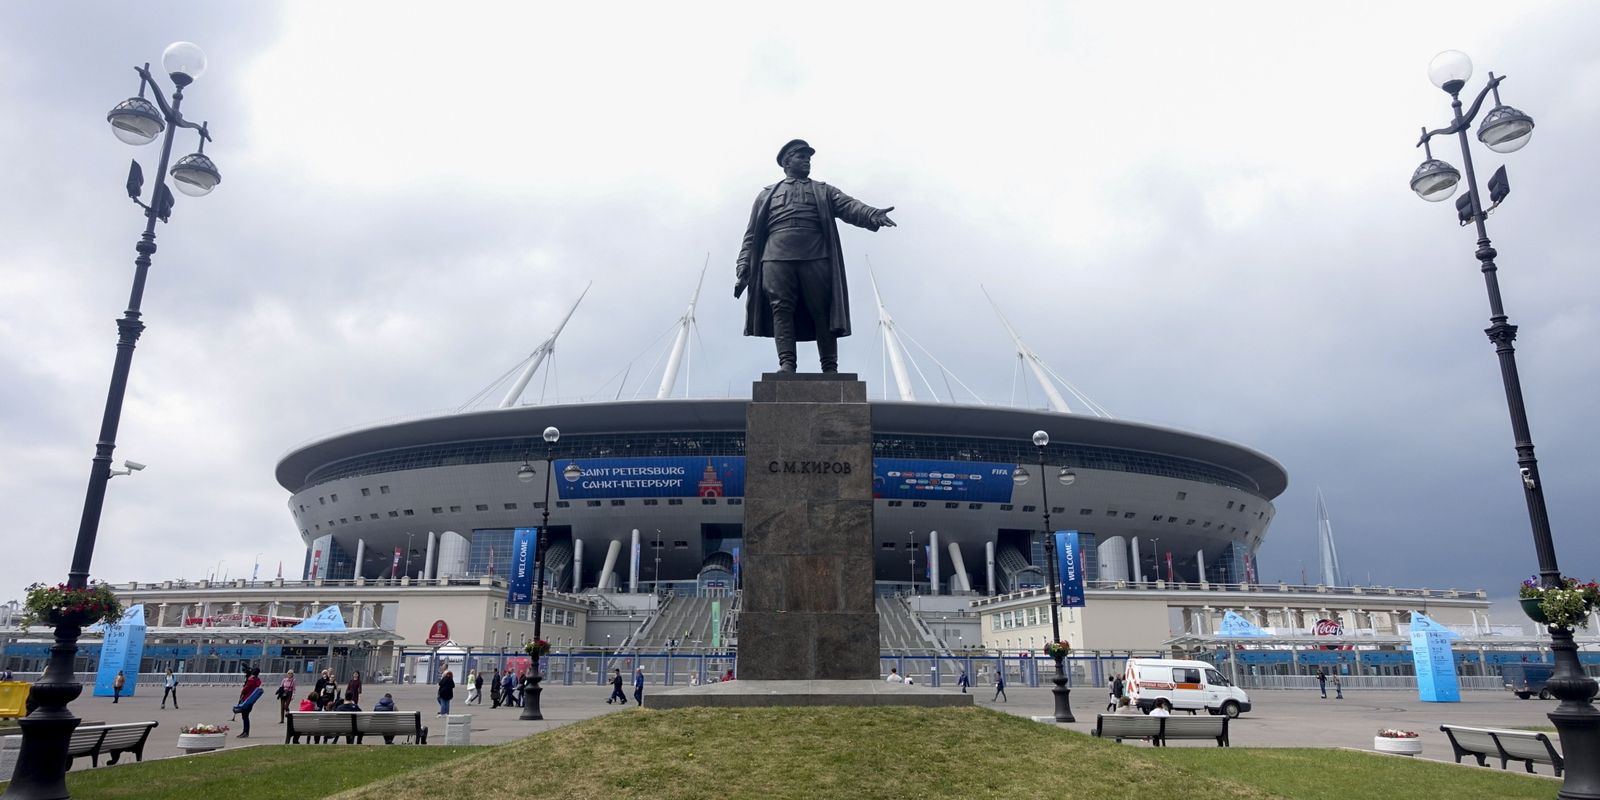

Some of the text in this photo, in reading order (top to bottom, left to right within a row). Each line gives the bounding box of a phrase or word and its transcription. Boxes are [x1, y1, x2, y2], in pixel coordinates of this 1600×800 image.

[580, 466, 685, 477] SAINT PETERSBURG
[582, 479, 683, 489] САНКТ-ПЕТЕРБУРГ
[518, 539, 529, 578] WELCOME
[1065, 542, 1075, 581] WELCOME
[1416, 617, 1430, 627] 5
